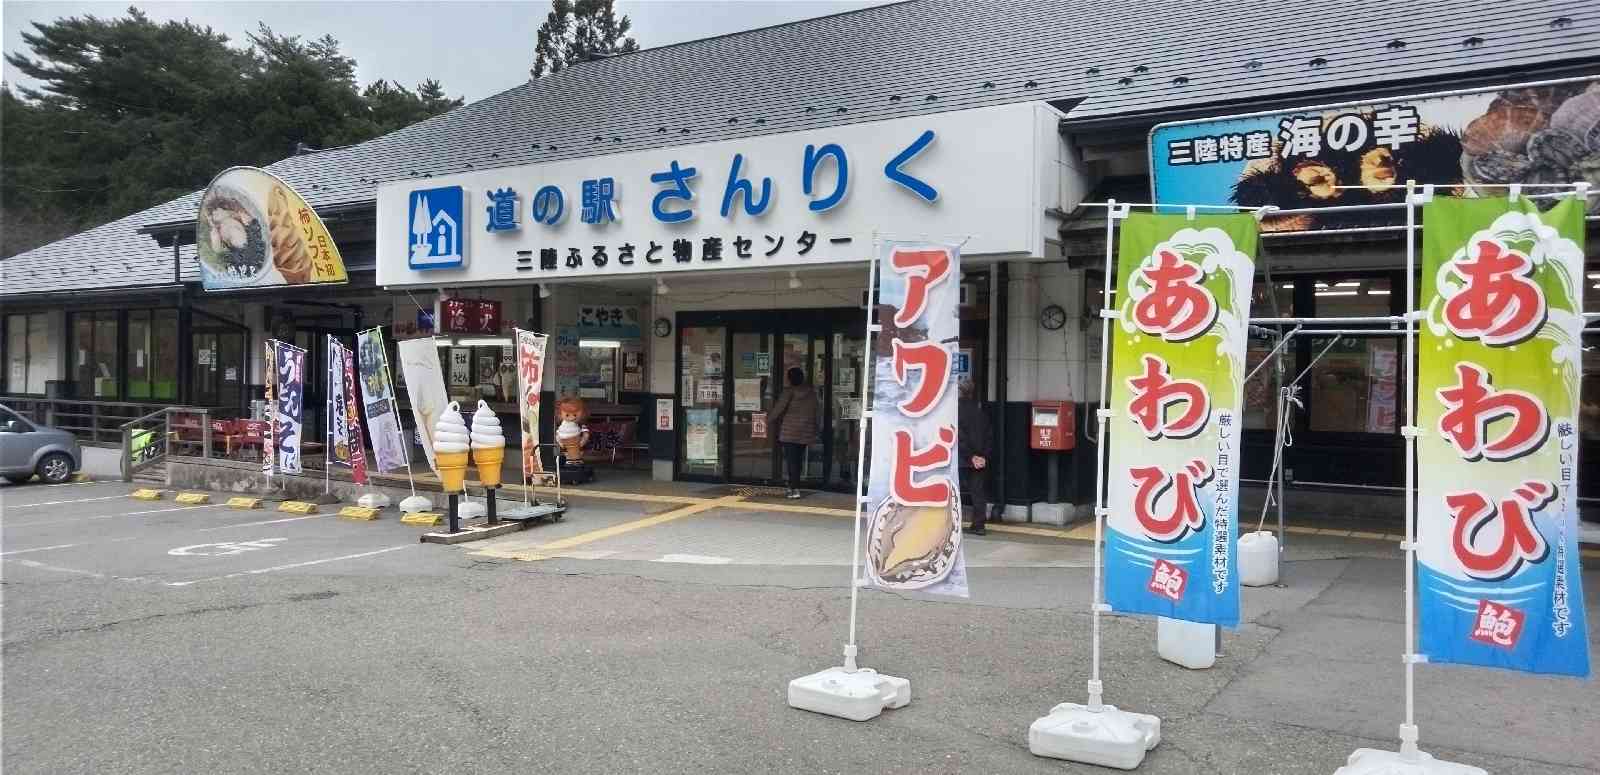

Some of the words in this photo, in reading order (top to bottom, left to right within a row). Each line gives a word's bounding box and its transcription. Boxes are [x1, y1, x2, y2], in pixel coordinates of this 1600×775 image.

[1169, 132, 1271, 165] 三陸特産
[1280, 108, 1418, 160] 海の幸
[486, 177, 616, 234] 道の駅
[650, 129, 939, 224] さんりく
[515, 231, 853, 271] 三陸ふるさと物産センター
[577, 306, 623, 328] こやき
[891, 248, 956, 506] アワビ
[1127, 250, 1217, 542] あわび
[1439, 239, 1553, 581] あわび
[1214, 414, 1233, 593] 厳しい目で選んだ特選素材です
[1150, 564, 1185, 601] 鮑
[1473, 605, 1519, 646] 鮑
